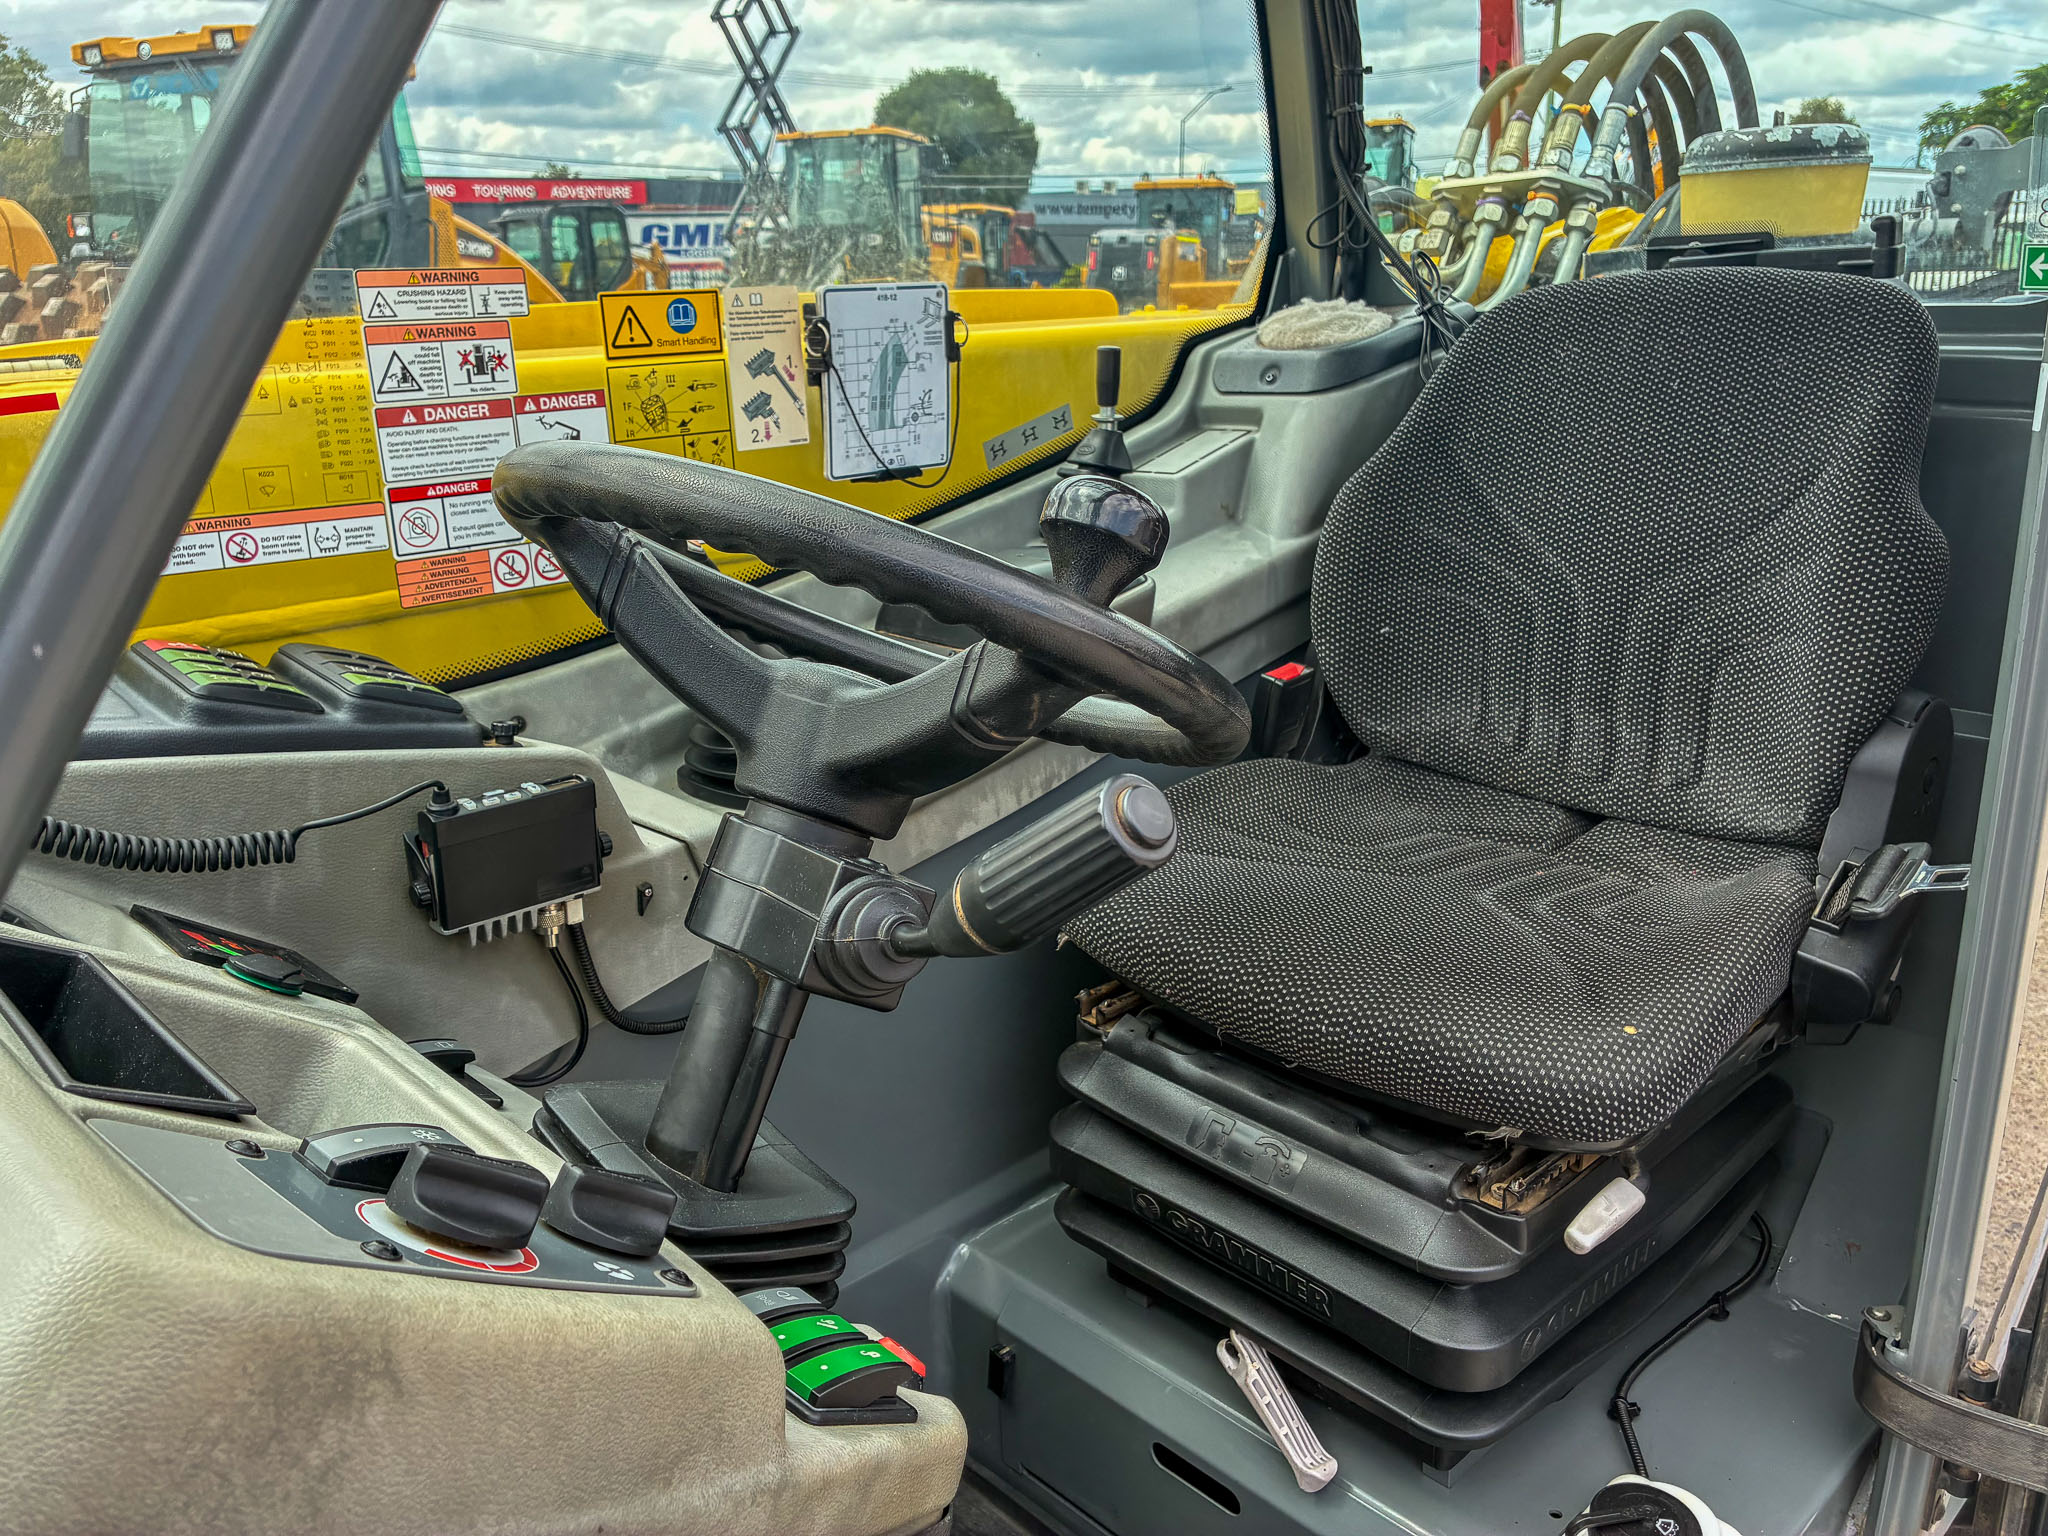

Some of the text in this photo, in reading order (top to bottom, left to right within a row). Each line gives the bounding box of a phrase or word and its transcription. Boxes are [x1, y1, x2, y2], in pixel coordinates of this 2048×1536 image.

[471, 184, 537, 199] TOURING
[550, 185, 633, 199] ADVENTURE
[420, 271, 479, 283] WARNING
[397, 288, 466, 298] CRUSHING HAZARD
[415, 326, 476, 338] WARNING
[656, 336, 717, 347] Smart Handling
[539, 393, 597, 410] DANGER
[424, 403, 490, 421] DANGER
[751, 429, 764, 443] 2.
[387, 440, 412, 448] Operating
[436, 482, 478, 495] DANGER
[195, 517, 251, 531] WARNING
[452, 524, 476, 532] Exhaust
[477, 523, 494, 531] gases
[429, 555, 466, 567] WARNING
[429, 566, 470, 578] WARNUNG
[424, 576, 478, 591] ADVERTENCIA
[421, 586, 483, 602] AVERTISSEMENT
[1166, 1210, 1331, 1317] GRAMMER
